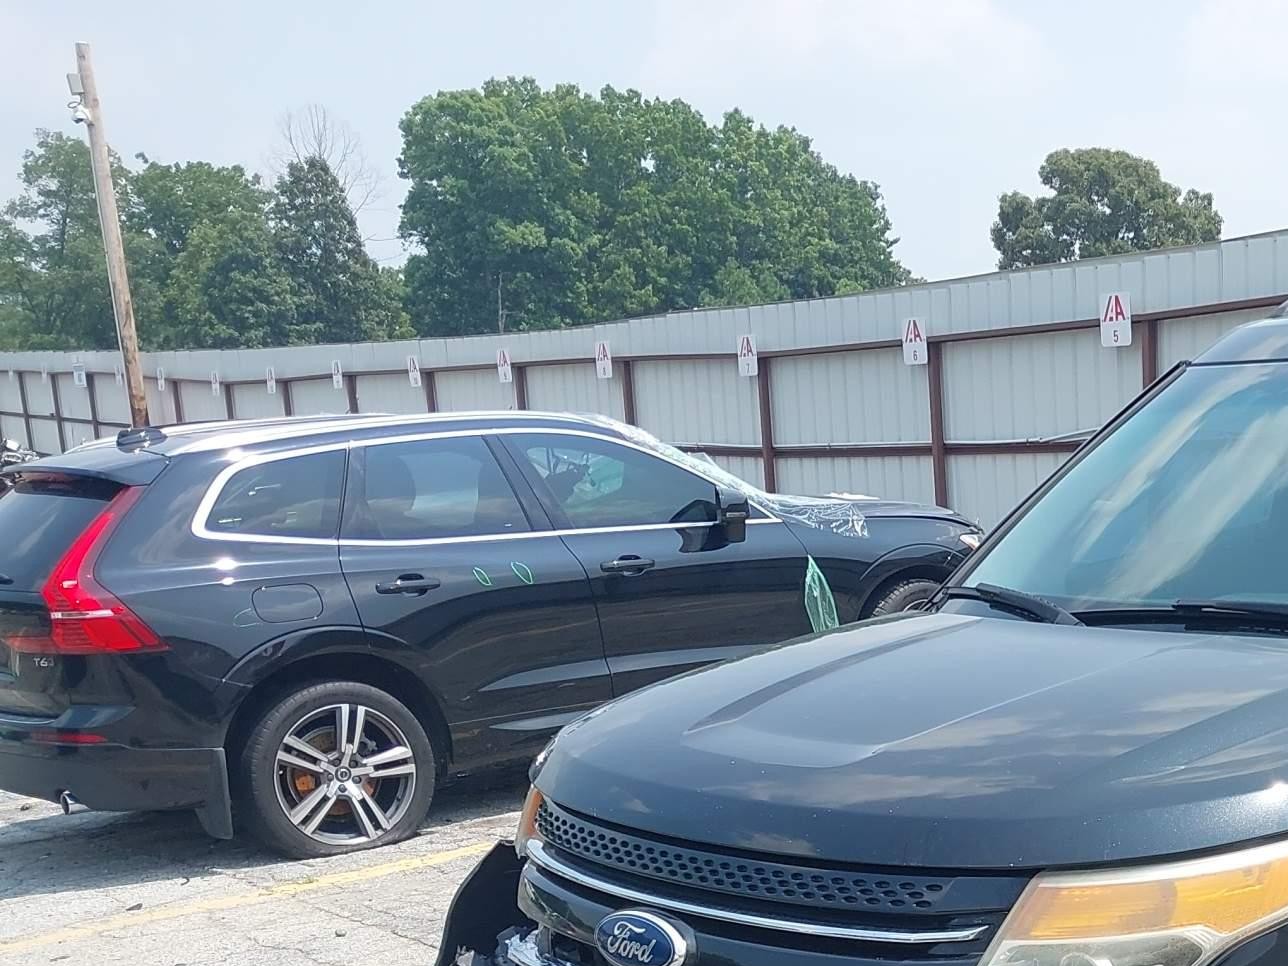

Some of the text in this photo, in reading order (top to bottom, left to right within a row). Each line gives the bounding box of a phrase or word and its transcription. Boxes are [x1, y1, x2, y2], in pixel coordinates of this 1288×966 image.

[1113, 329, 1119, 343] 5
[913, 350, 918, 361] 6
[607, 921, 657, 963] Ford
